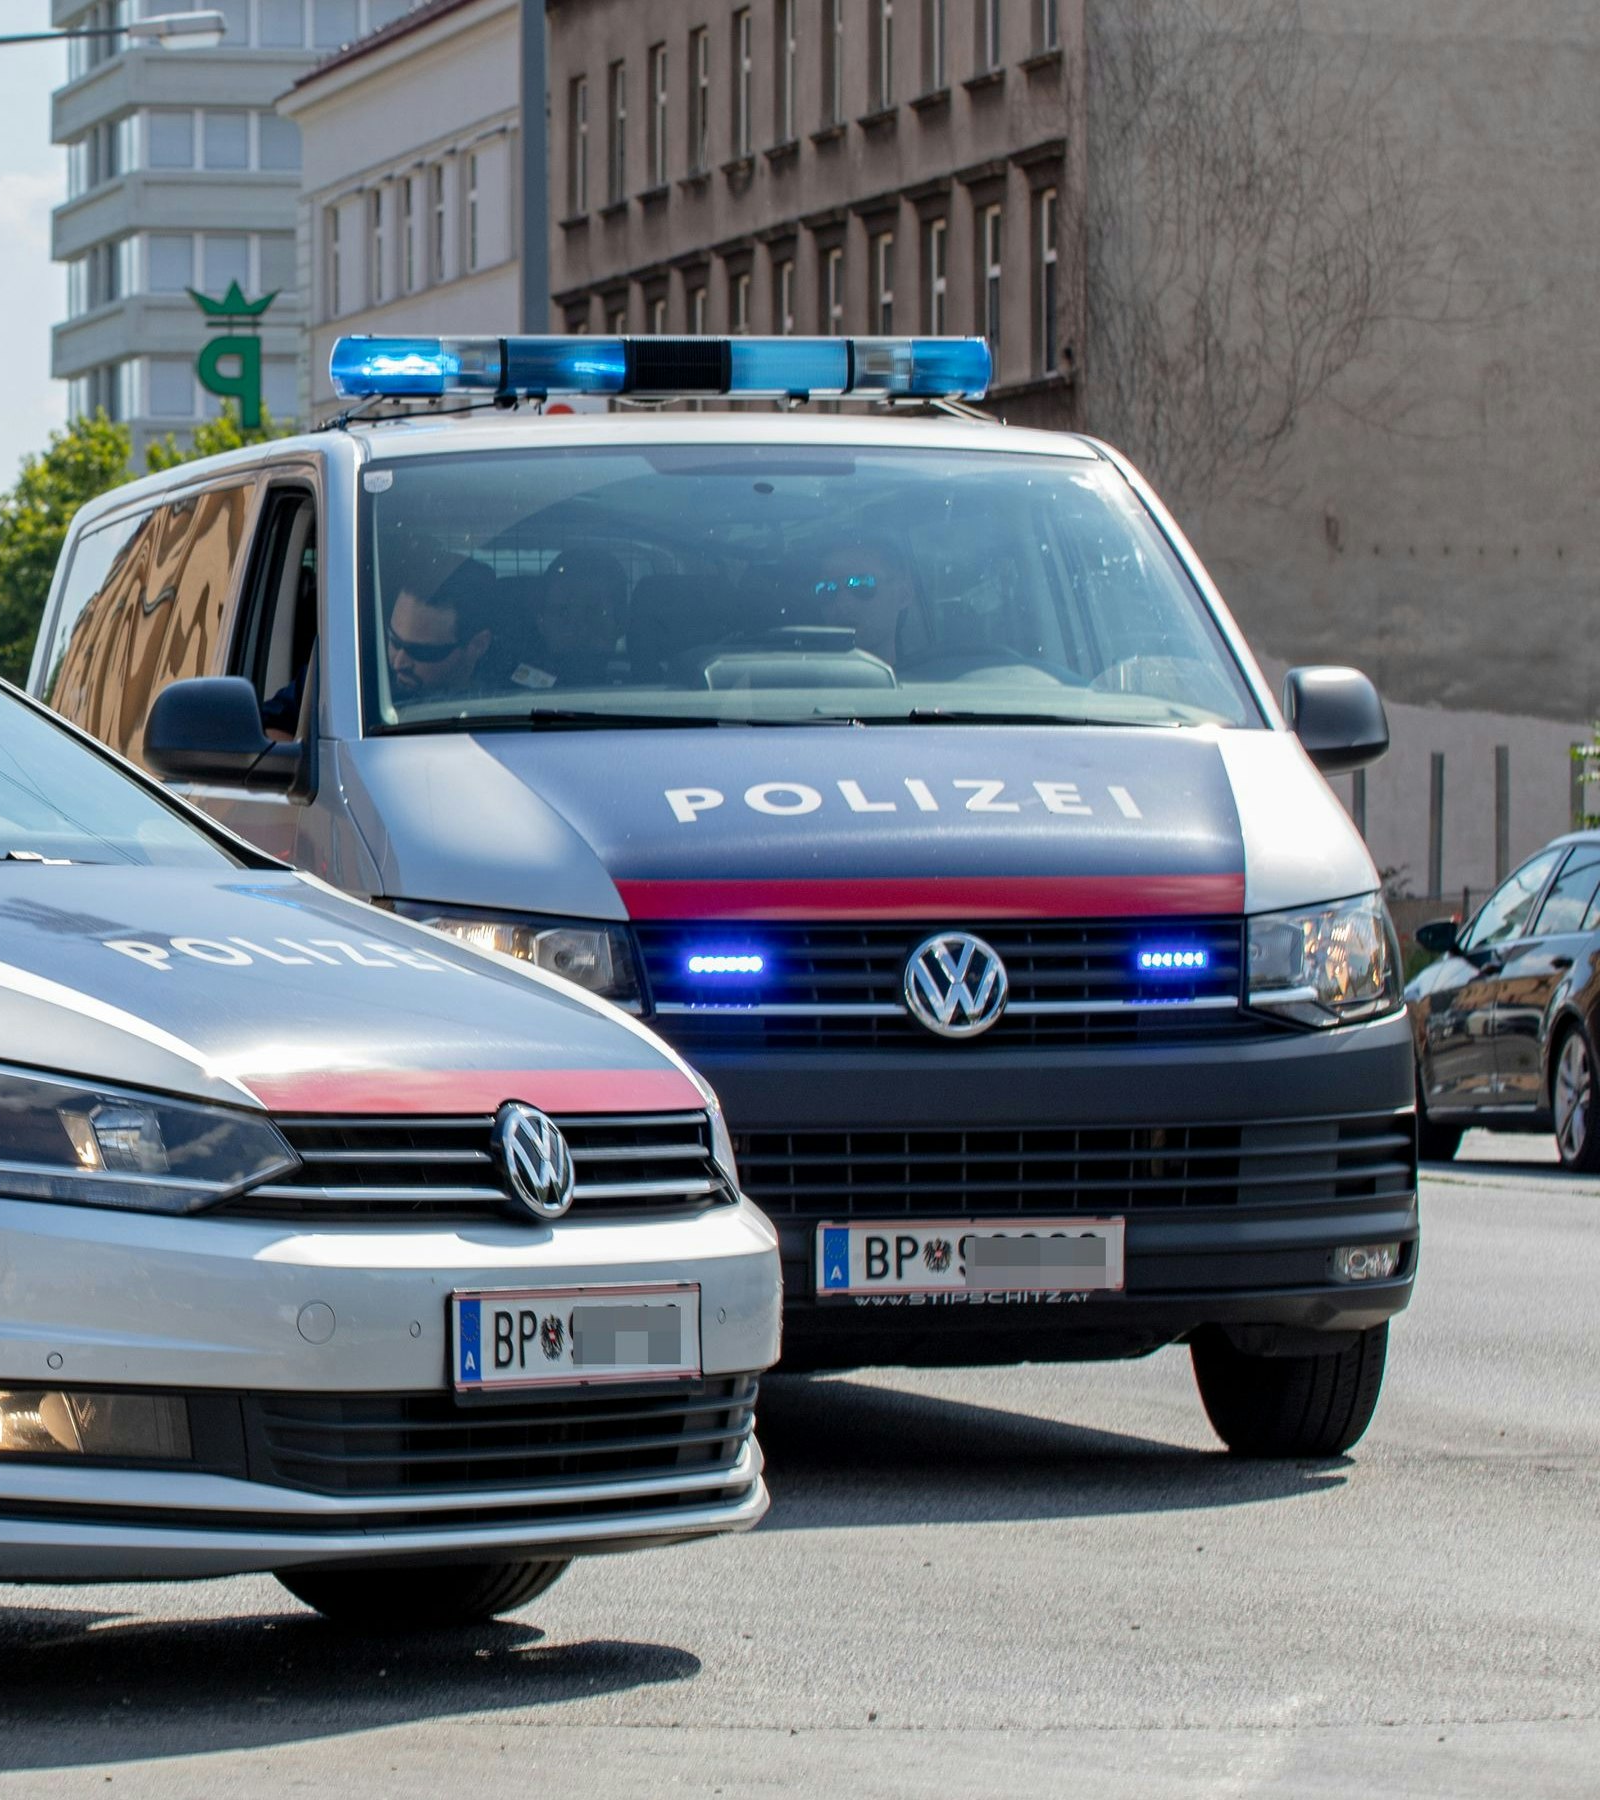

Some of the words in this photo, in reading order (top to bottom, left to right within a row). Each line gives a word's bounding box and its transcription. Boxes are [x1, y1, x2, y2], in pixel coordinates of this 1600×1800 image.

[664, 778, 1144, 823] POLIZEI
[102, 936, 480, 976] POLIZEI
[908, 933, 1005, 1034] VW
[830, 1265, 842, 1281] A
[865, 1235, 918, 1280] BP
[464, 1350, 476, 1371] A
[494, 1310, 537, 1368] BP
